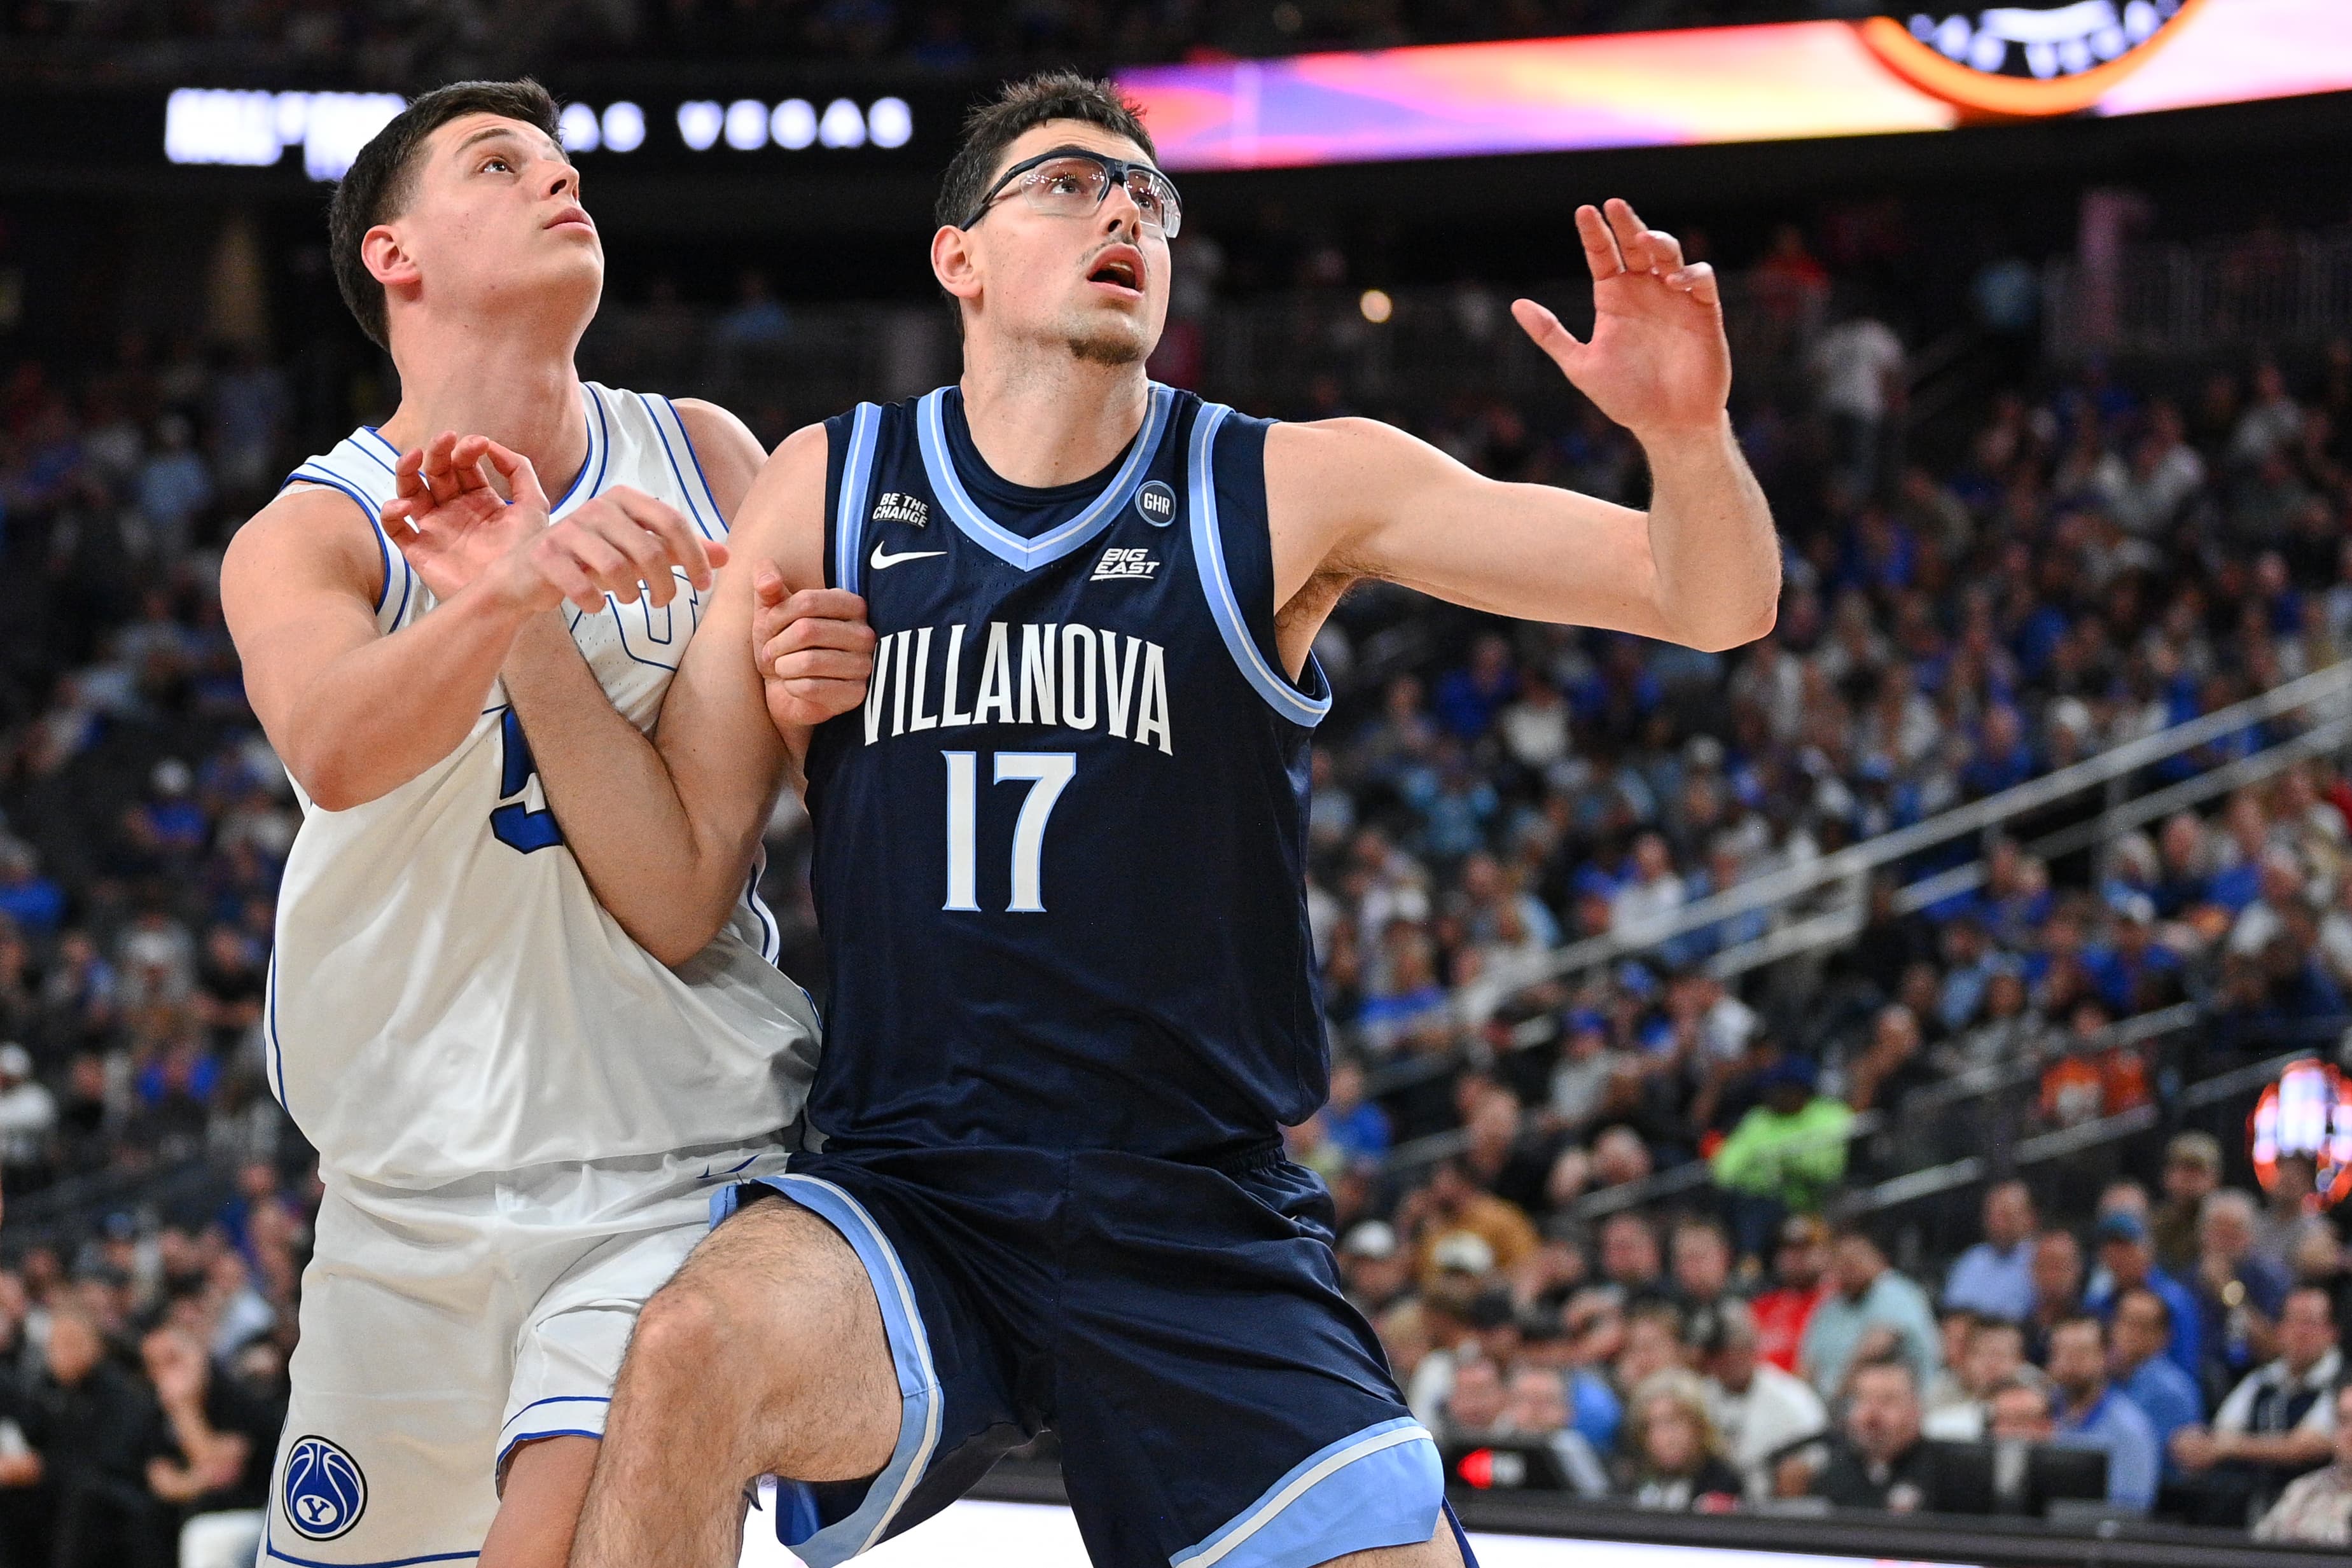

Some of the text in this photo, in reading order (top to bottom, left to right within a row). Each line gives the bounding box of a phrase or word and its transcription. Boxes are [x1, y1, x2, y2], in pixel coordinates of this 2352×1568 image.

[879, 492, 928, 515] BE THE
[1144, 492, 1171, 515] GHR
[872, 505, 928, 527] CHANGE
[1101, 548, 1148, 562] BIG
[1094, 561, 1160, 574] EAST
[864, 621, 1173, 756] VILLANOVA
[940, 750, 1077, 913] 17
[303, 1497, 330, 1522] Y
